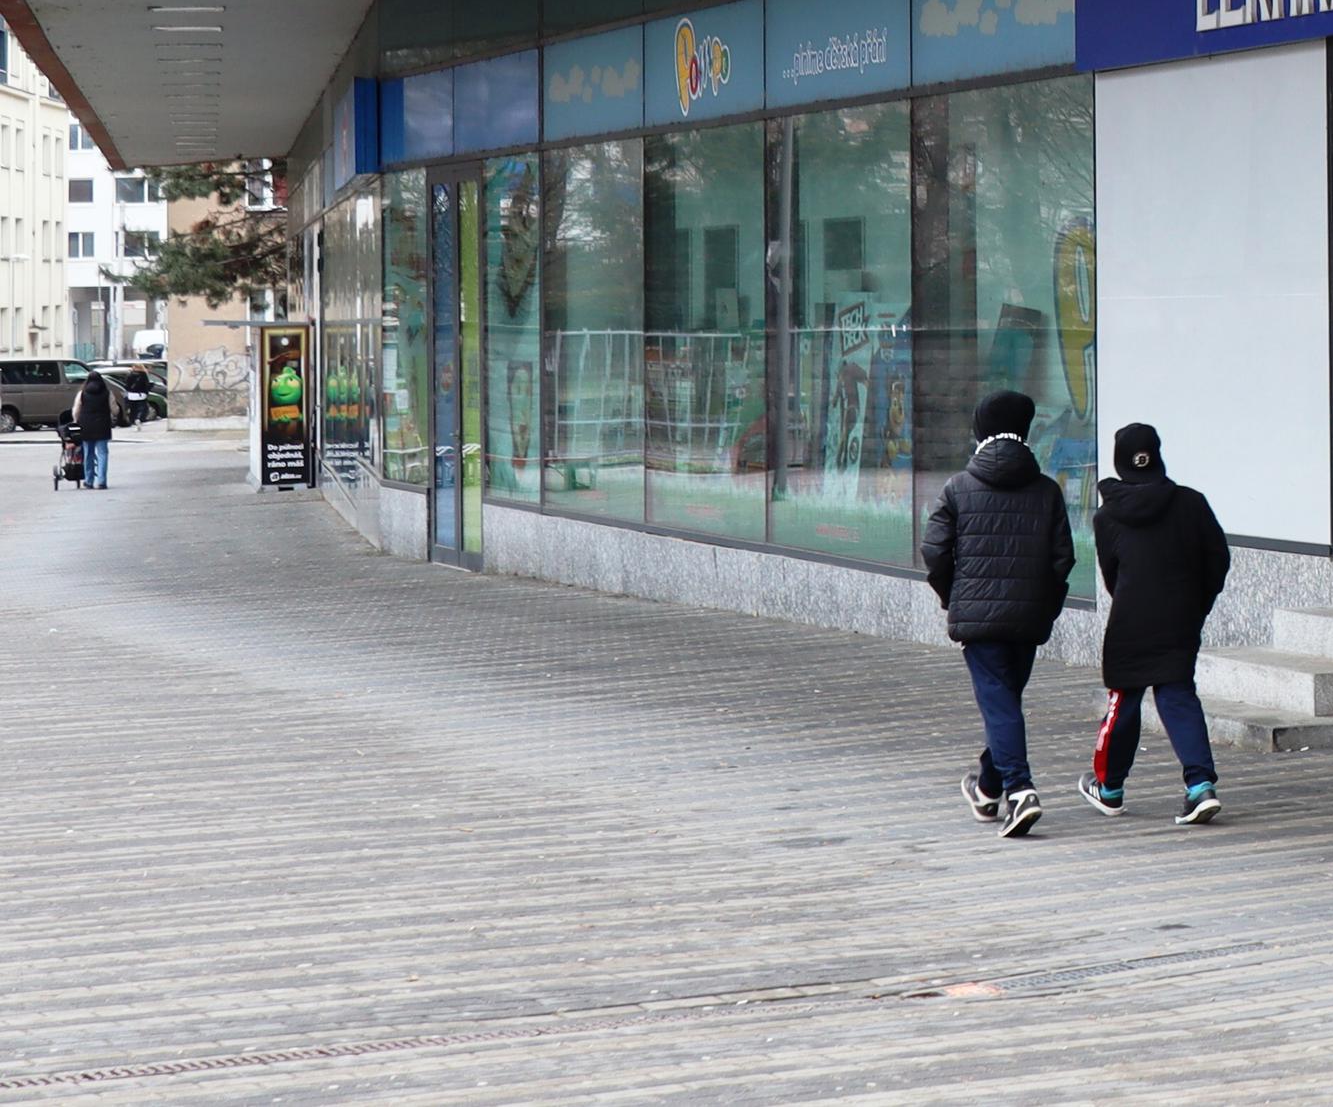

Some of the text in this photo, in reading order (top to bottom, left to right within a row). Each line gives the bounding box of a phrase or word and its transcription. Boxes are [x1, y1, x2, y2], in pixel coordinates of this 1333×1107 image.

[824, 32, 859, 71] dětská
[860, 27, 887, 74] přání
[841, 305, 864, 331] TECH
[842, 326, 867, 352] DECK
